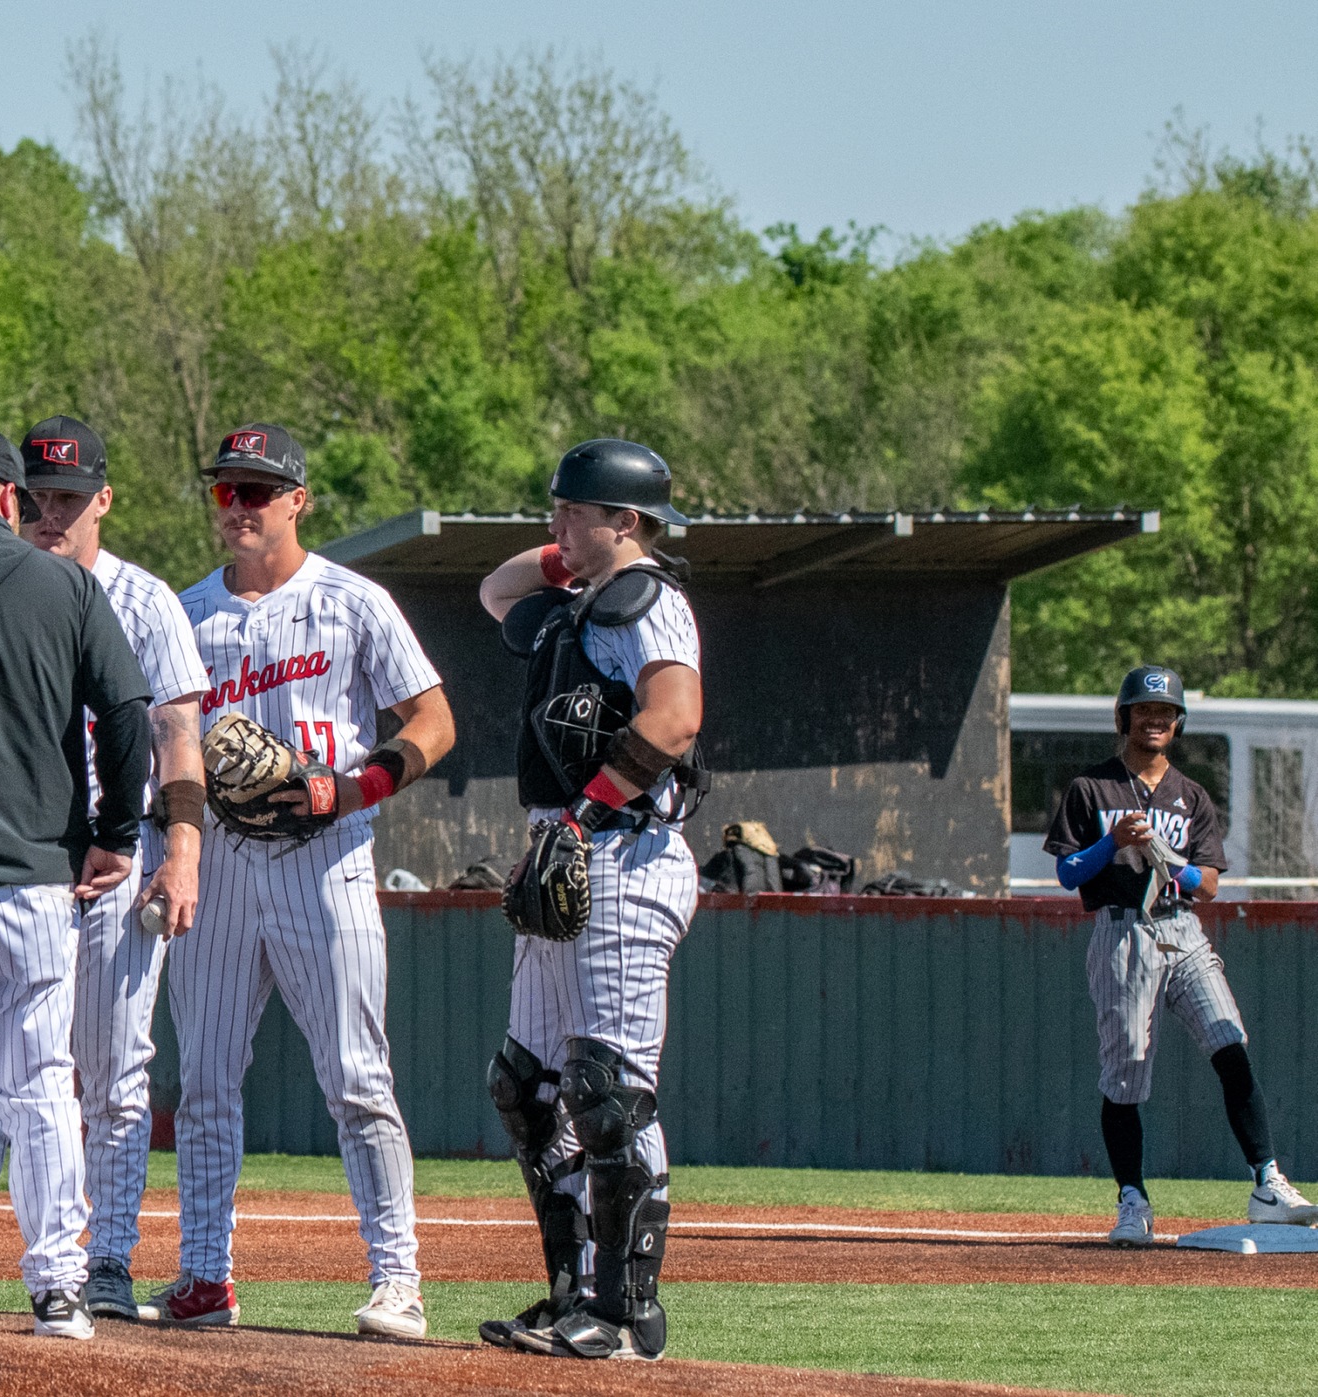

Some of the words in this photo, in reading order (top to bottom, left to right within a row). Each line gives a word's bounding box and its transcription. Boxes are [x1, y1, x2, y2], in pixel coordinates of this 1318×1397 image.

[202, 651, 330, 715] onkawa
[294, 721, 335, 767] 17
[1099, 808, 1192, 849] VIINGS
